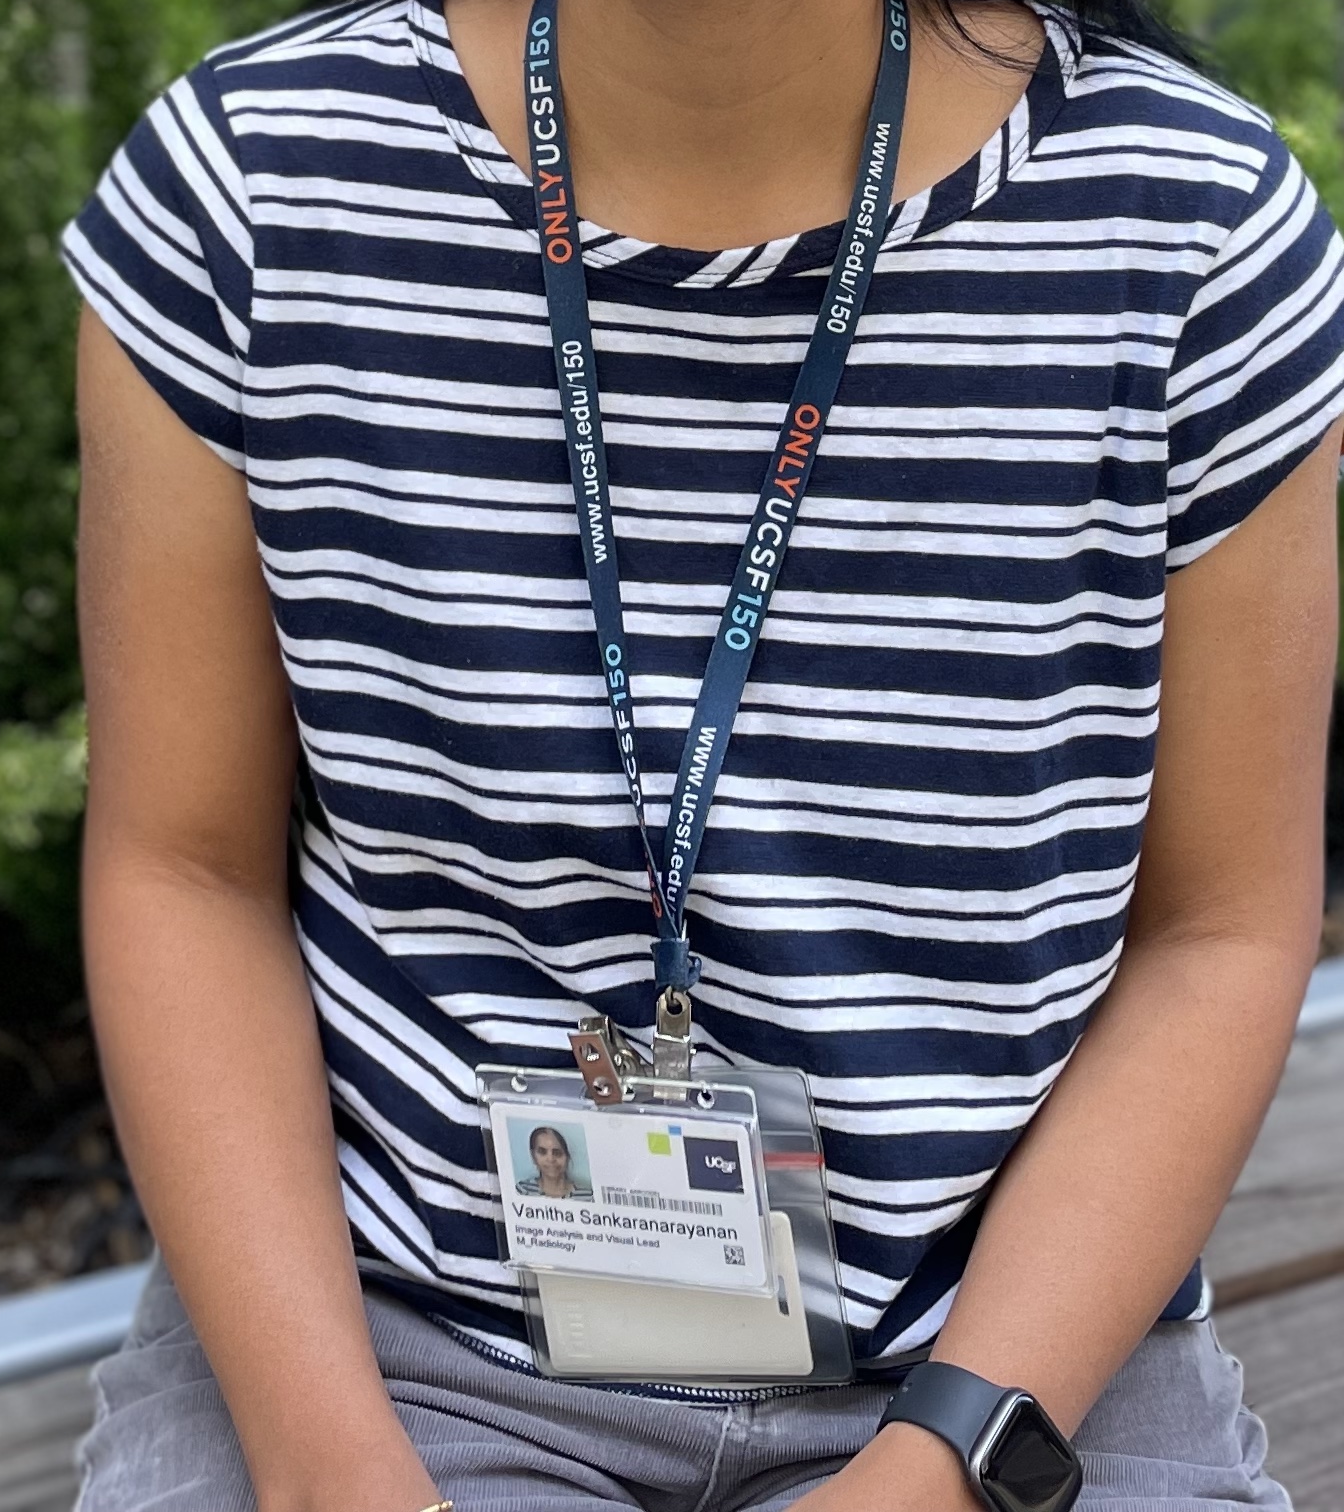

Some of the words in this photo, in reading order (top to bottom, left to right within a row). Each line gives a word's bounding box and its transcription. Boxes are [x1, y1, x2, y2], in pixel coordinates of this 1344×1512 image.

[529, 16, 573, 264] ONLYUCSF150
[826, 123, 891, 334] www.ucsf.edu/150
[561, 340, 608, 564] www.ucsf.edu/150
[724, 403, 821, 651] ONLYUCSF150
[511, 1202, 574, 1224] Vanitha
[579, 1209, 738, 1240] Sankaranarayanan
[515, 1225, 544, 1237] Image
[586, 1233, 604, 1243] and
[606, 1235, 634, 1245] Visual
[636, 1237, 661, 1249] Lead
